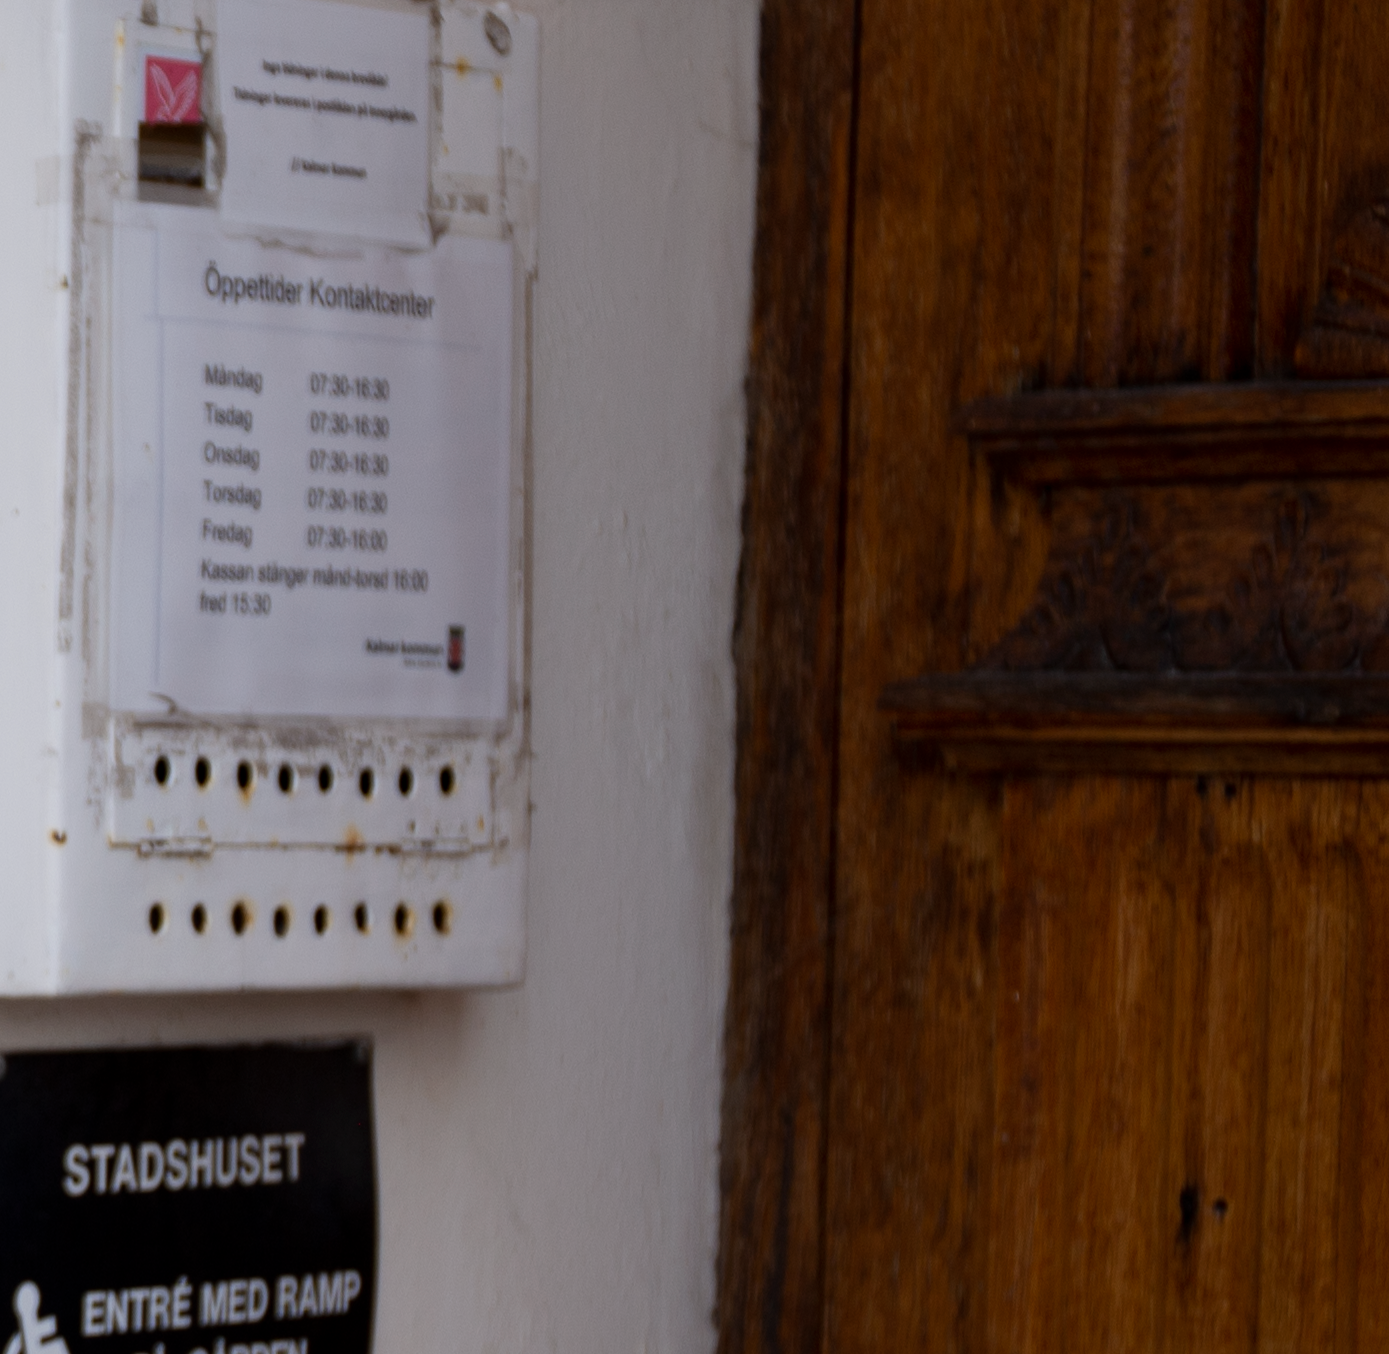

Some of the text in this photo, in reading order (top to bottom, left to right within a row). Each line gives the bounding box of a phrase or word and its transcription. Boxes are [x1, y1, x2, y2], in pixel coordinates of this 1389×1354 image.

[205, 260, 435, 319] Öppettider Kontaktcenter
[204, 363, 263, 395] Måndag
[204, 401, 253, 433] Tisdag
[204, 440, 260, 472] Onsdag
[203, 478, 262, 511] Torsdag
[202, 518, 253, 549] Fredag
[200, 558, 255, 583] Kassan
[258, 561, 309, 590] stänger
[199, 589, 227, 614] fred
[63, 1133, 305, 1196] STADSHUSET
[82, 1270, 361, 1337] ENTRÉ MED RAMP
